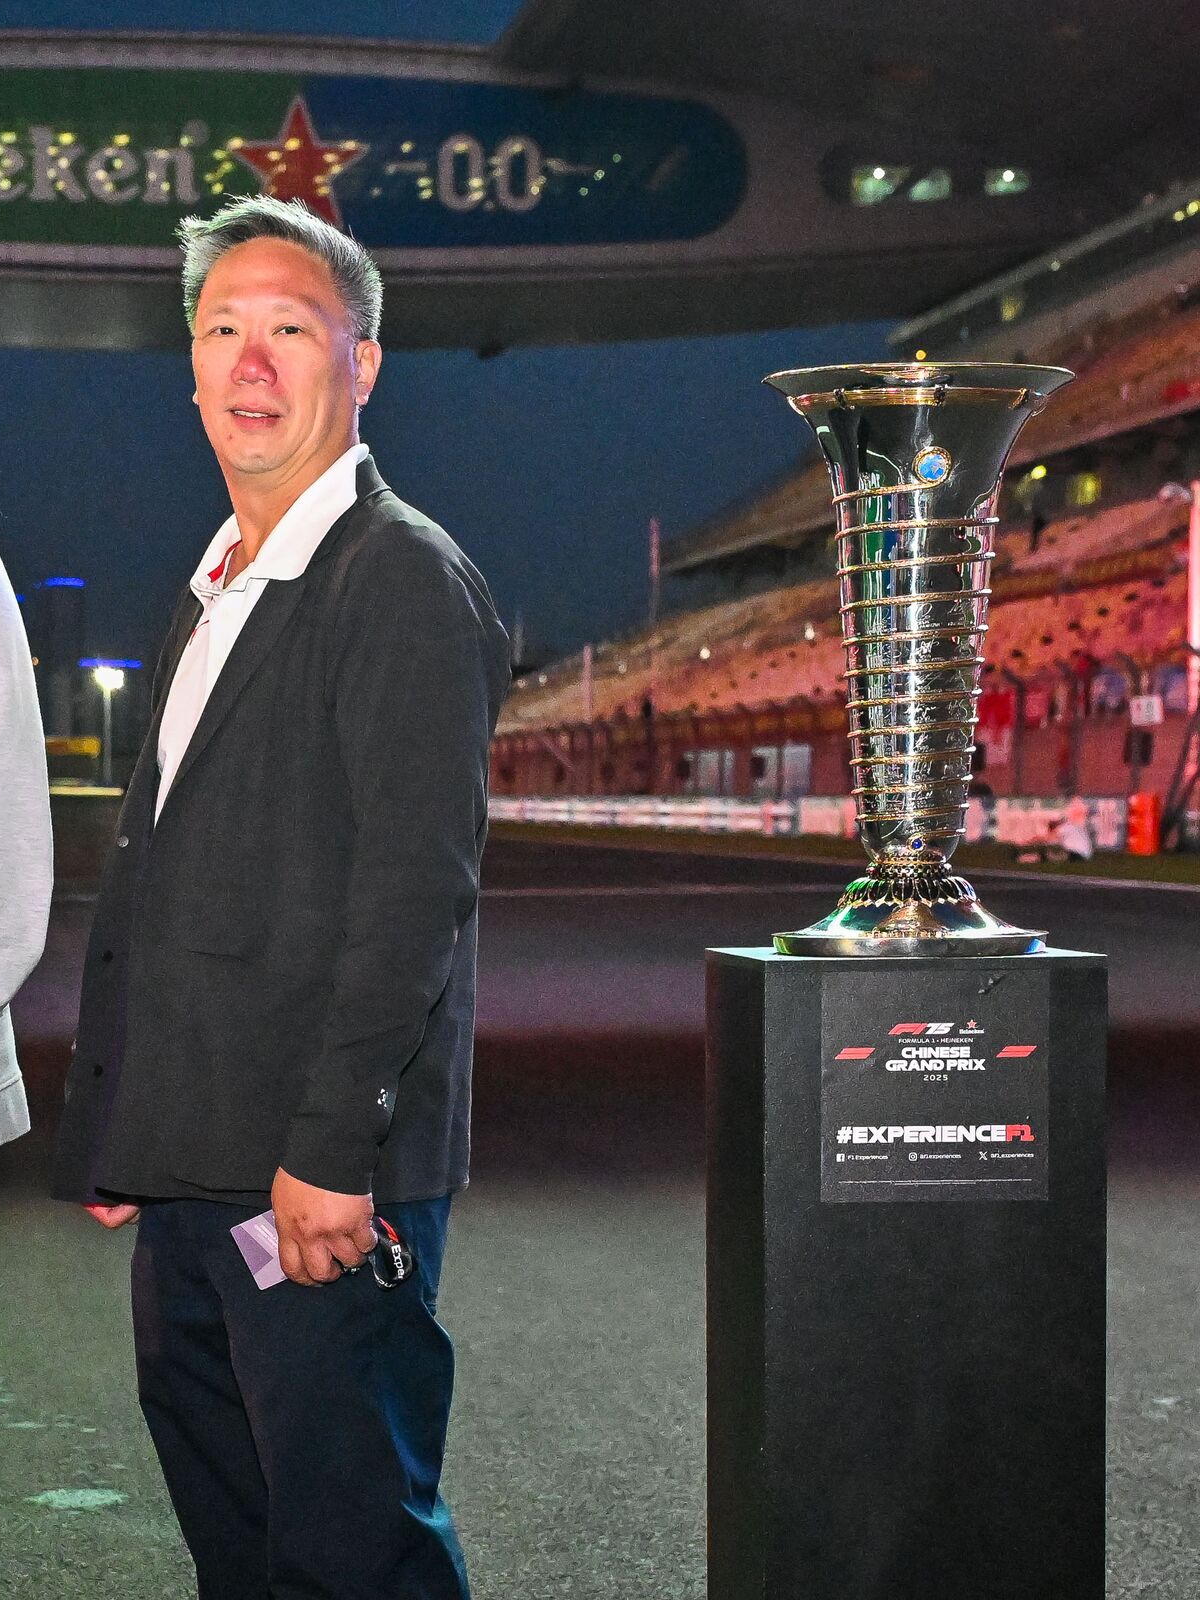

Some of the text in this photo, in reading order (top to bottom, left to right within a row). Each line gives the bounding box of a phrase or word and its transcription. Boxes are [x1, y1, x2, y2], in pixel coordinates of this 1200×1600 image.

[436, 134, 544, 213] 0.0
[901, 1046, 971, 1059] CHINESE
[885, 1058, 986, 1072] GRAND PRIX
[836, 1124, 1035, 1144] #EXPERIENCEF1
